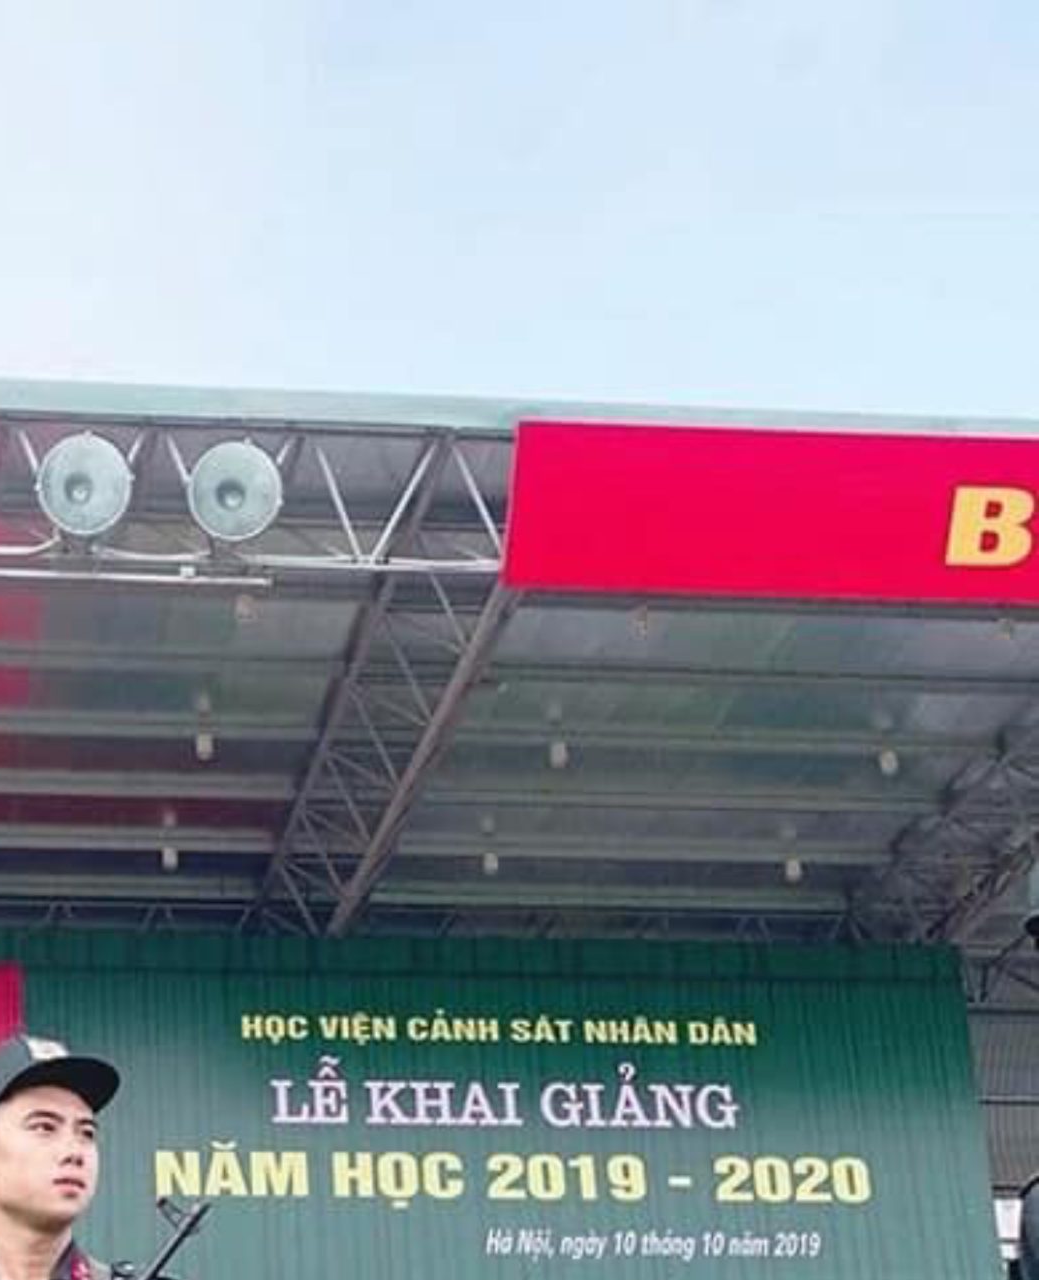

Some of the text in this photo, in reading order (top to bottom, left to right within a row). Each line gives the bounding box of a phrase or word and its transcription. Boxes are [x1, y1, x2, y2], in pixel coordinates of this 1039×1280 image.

[945, 485, 1035, 567] B
[241, 1008, 757, 1046] HỌC VIỆN CẢNH SÁT NHÂN DÂN
[269, 1055, 740, 1129] LỄ KHAI GIẢNG
[155, 1140, 871, 1209] NĂM HỌC 2019 - 2020
[486, 1227, 822, 1263] Hà Nội, ngày 10 tháng 10 năm 2019
